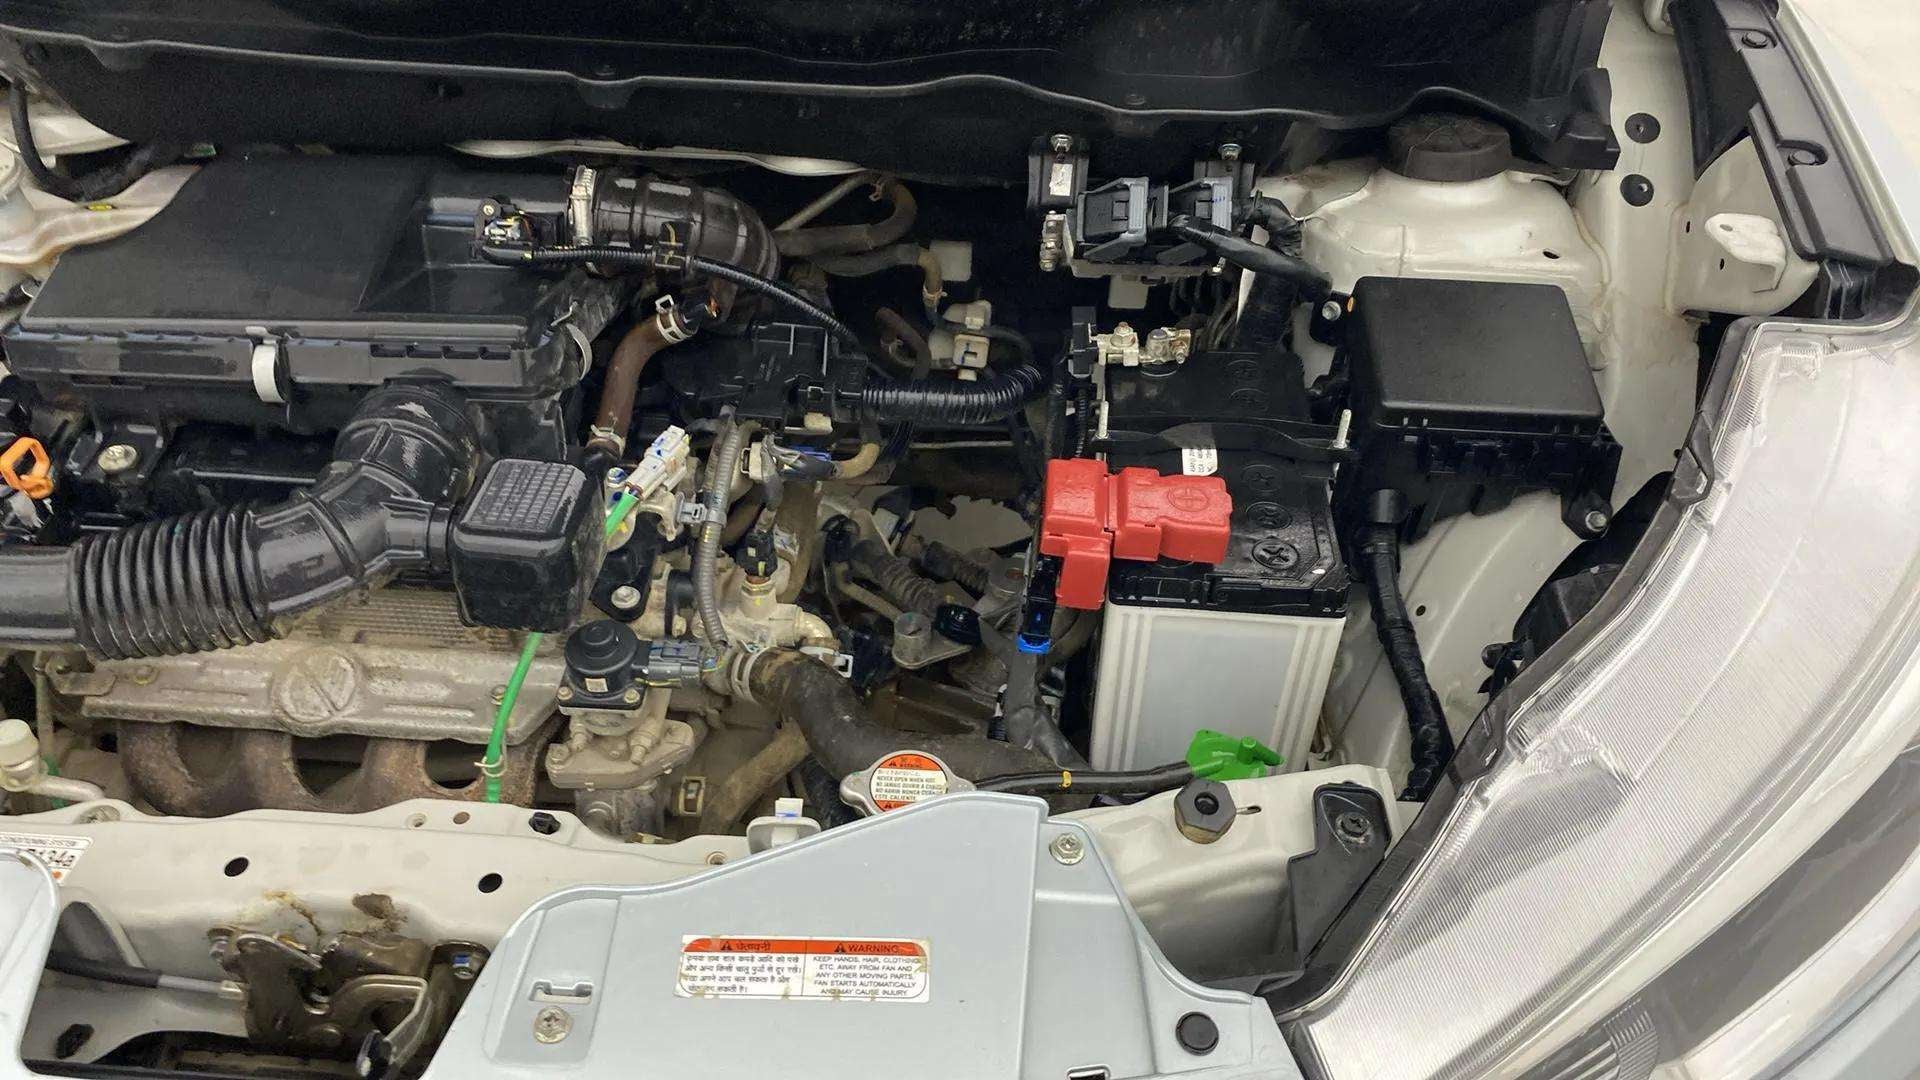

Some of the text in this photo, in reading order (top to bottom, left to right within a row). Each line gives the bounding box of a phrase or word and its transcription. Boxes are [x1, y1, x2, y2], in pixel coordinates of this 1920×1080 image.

[736, 940, 771, 951] चेतावनी
[848, 944, 899, 953] WARNING
[776, 967, 784, 975] दूर
[770, 975, 776, 983] है
